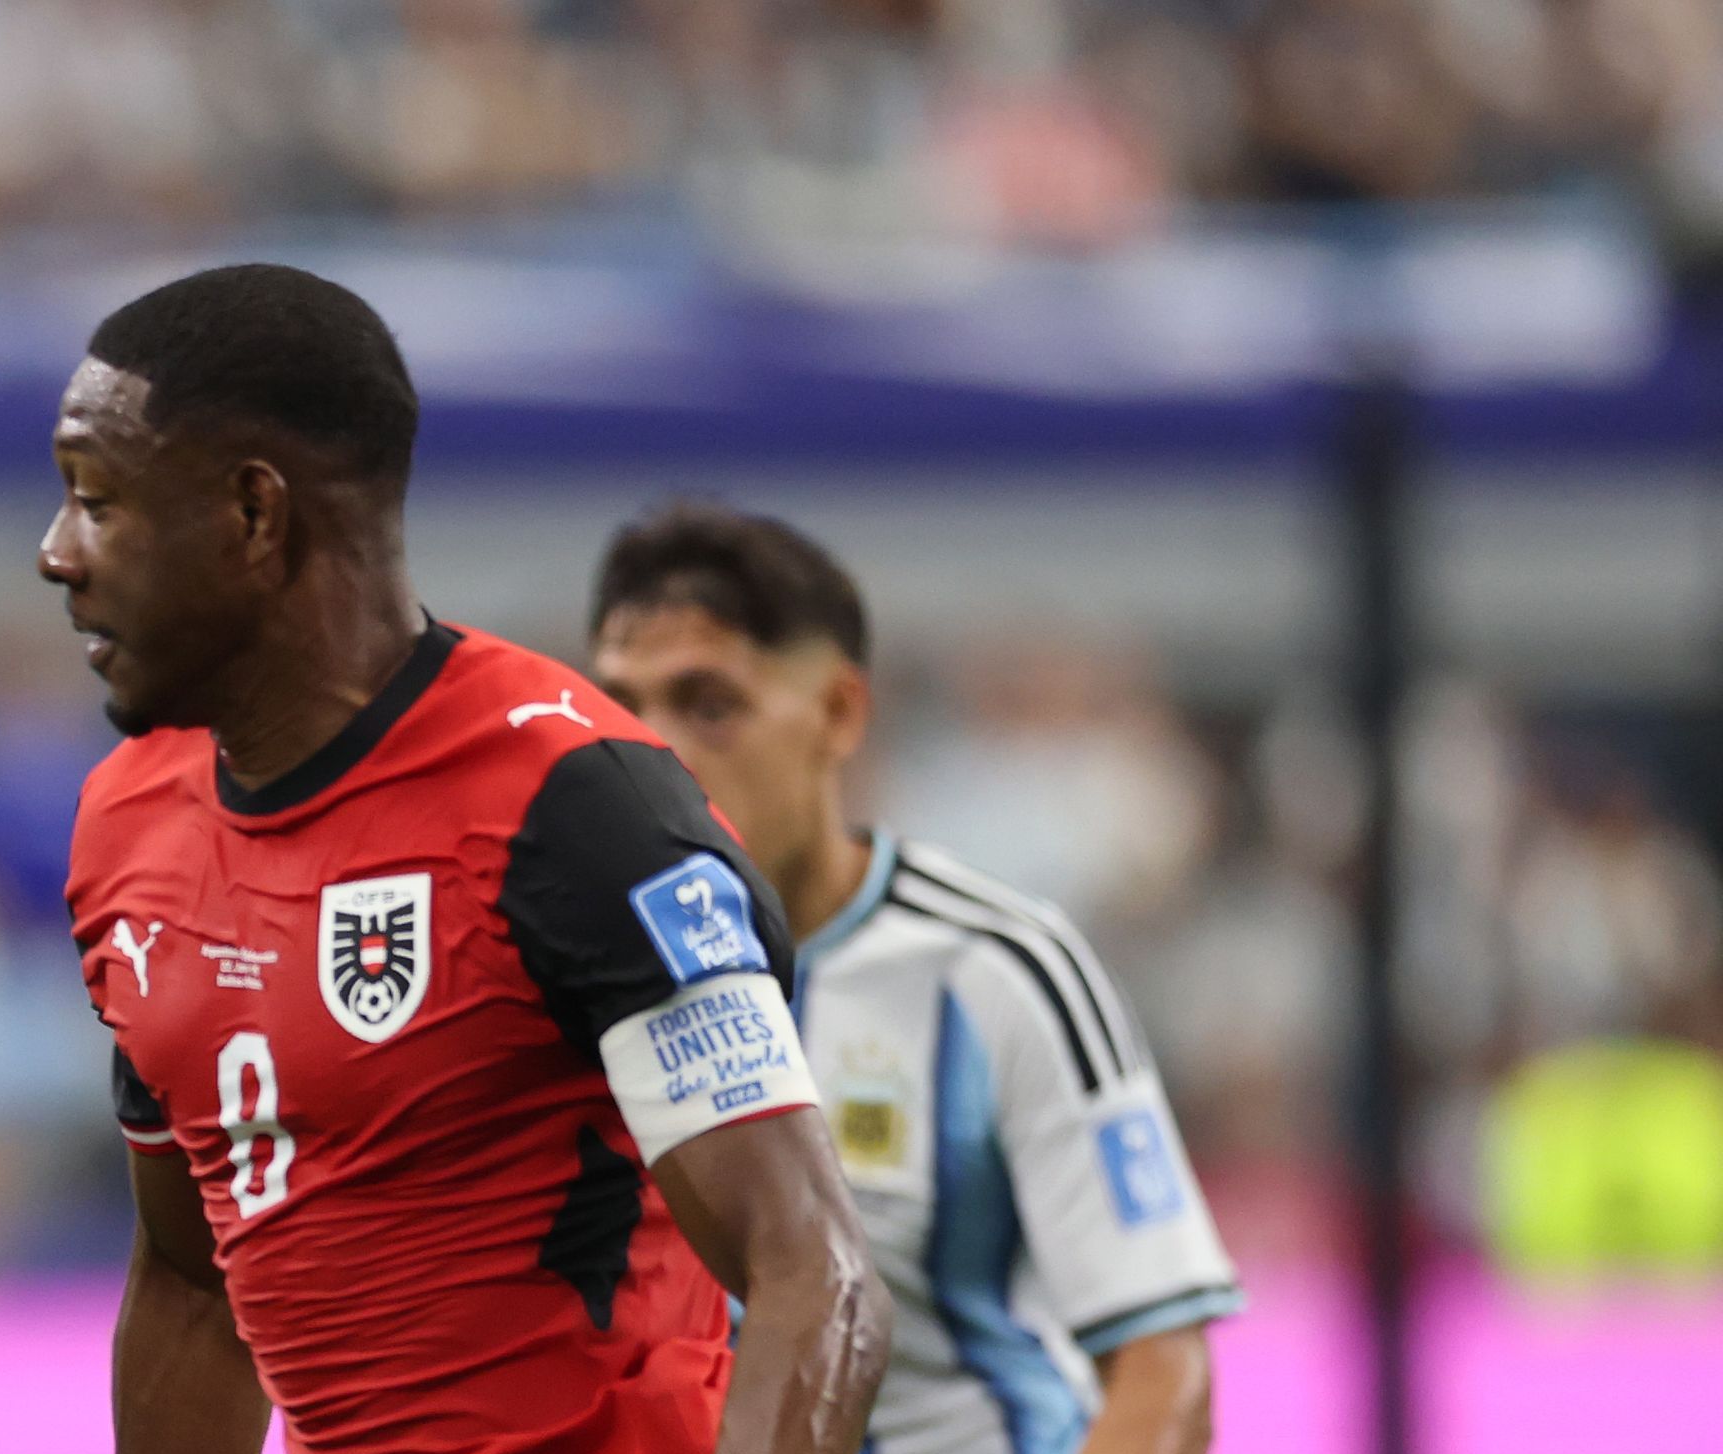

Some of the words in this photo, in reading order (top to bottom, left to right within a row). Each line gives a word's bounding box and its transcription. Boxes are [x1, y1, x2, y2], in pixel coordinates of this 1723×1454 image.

[646, 989, 757, 1041] FOOTBALL
[656, 1011, 773, 1073] UNITES
[713, 1046, 789, 1082] World
[217, 1031, 296, 1220] 8
